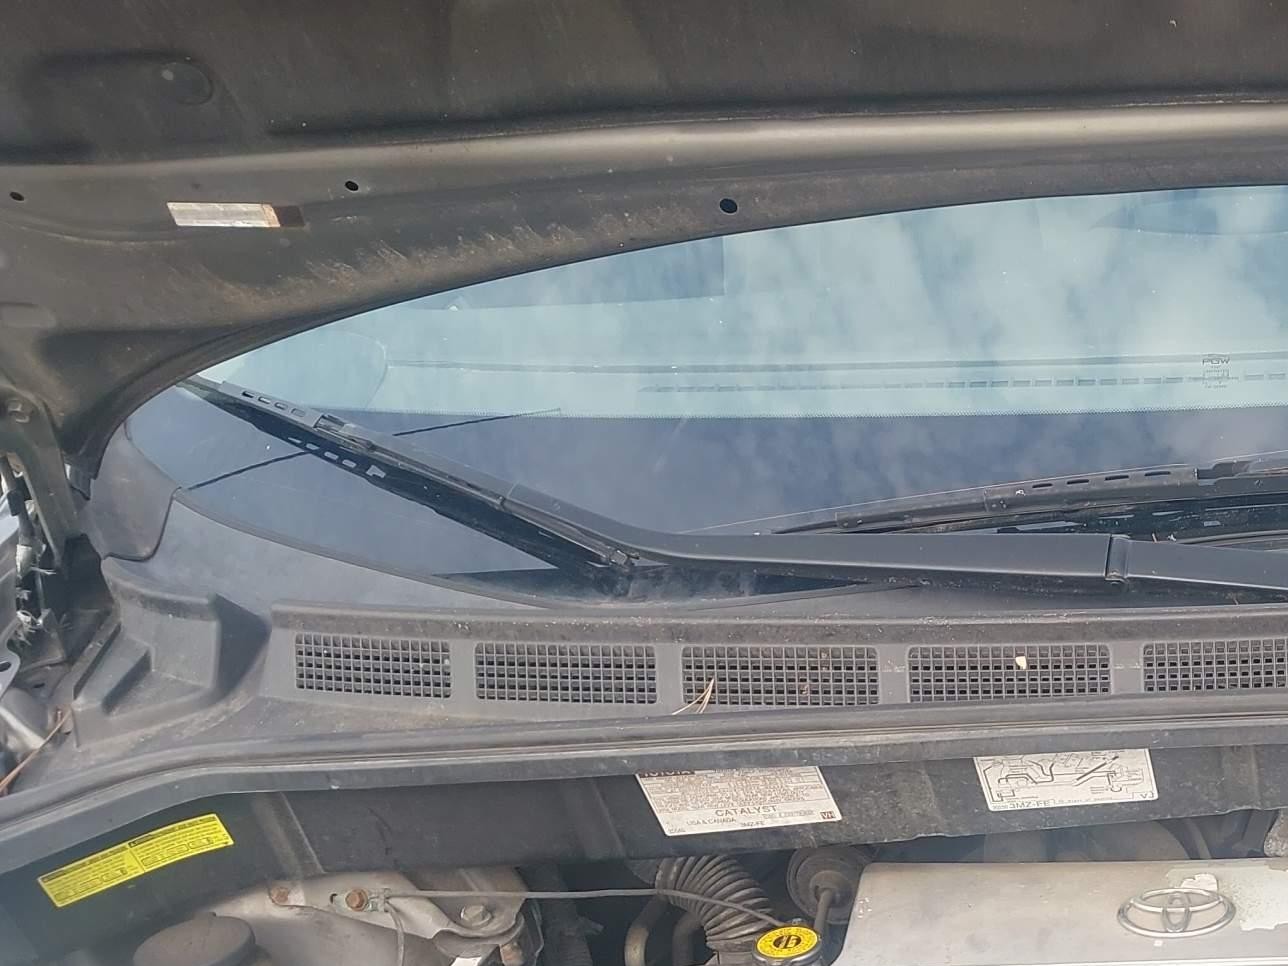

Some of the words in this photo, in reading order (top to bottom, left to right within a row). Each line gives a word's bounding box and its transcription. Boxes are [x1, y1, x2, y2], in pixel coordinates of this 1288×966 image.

[1009, 800, 1050, 809] 3MZ-FE
[714, 804, 778, 817] CATALYST
[708, 817, 737, 825] CANADA
